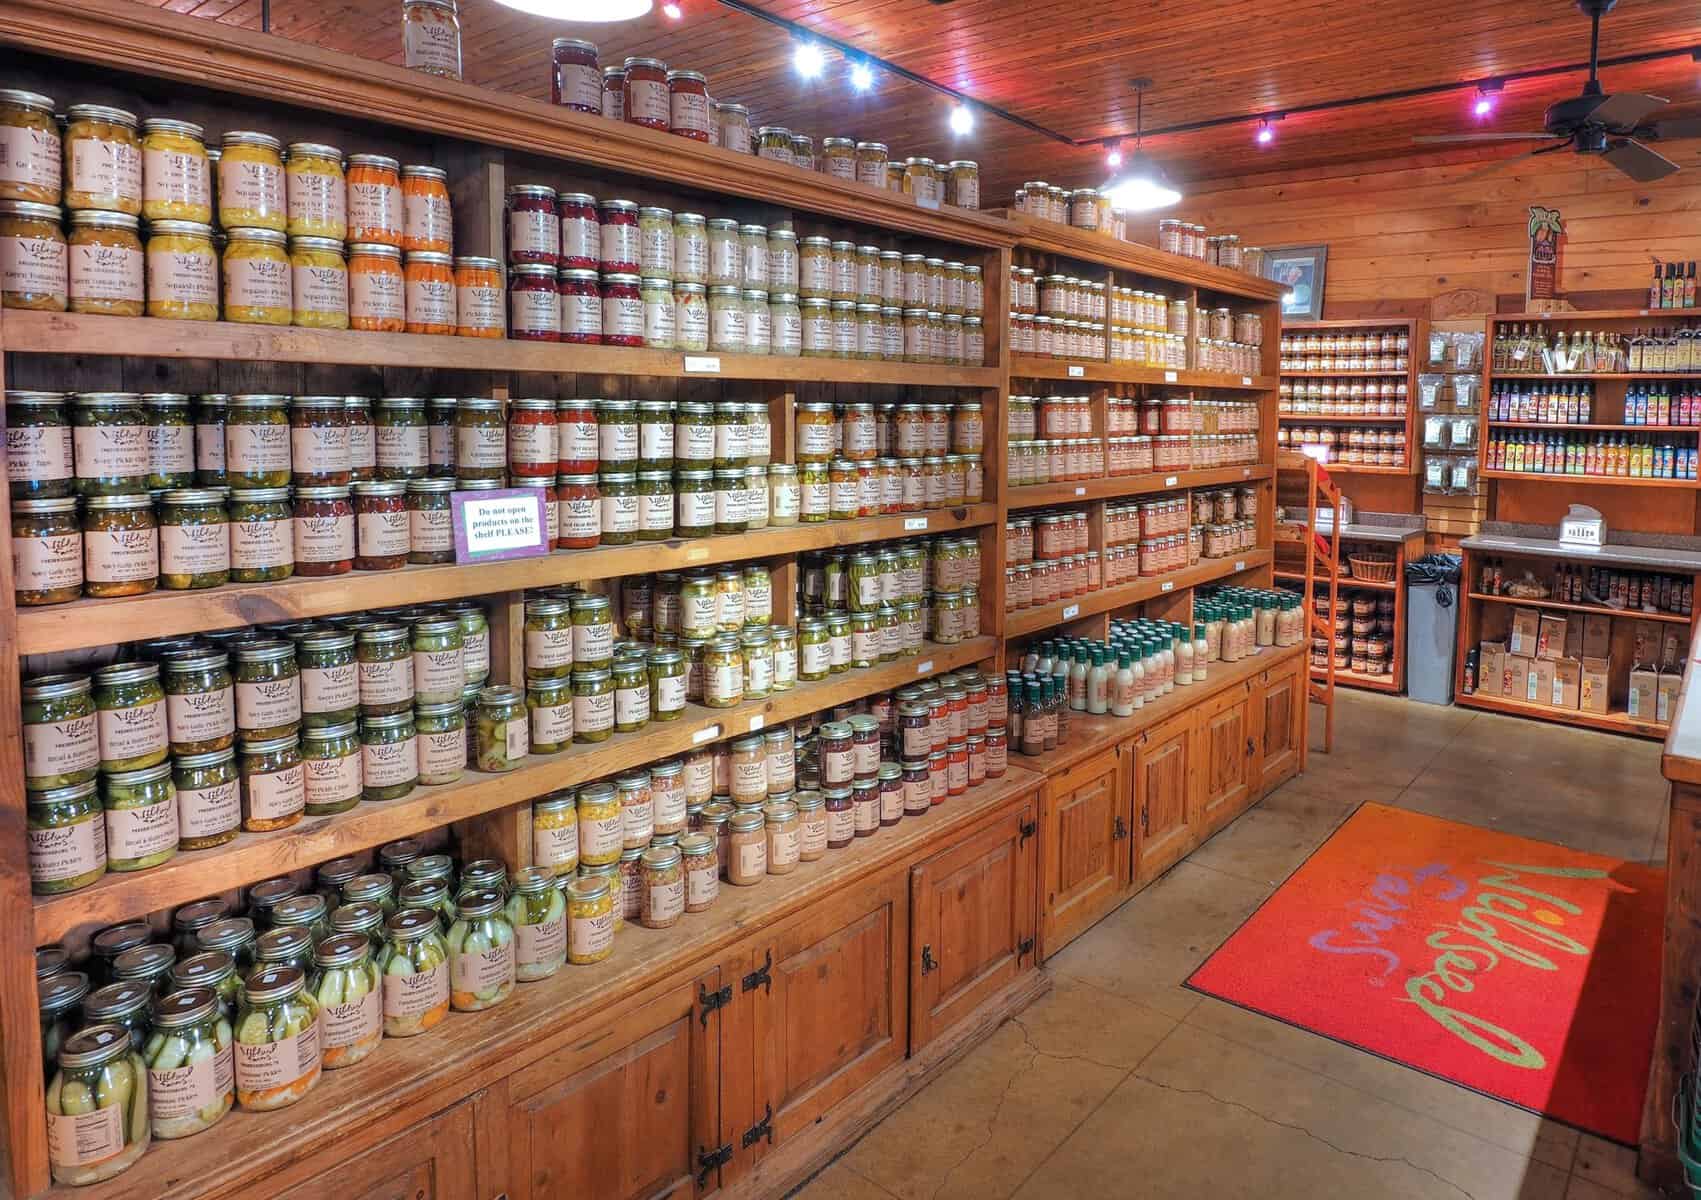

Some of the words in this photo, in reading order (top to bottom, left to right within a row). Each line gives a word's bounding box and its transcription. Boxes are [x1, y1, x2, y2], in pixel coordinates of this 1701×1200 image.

[478, 508, 490, 516] Do
[507, 506, 526, 517] open
[472, 518, 508, 529] products
[522, 516, 534, 524] the
[474, 529, 494, 539] shelf
[1309, 862, 1470, 978] Farms
[1394, 859, 1609, 1070] Wildseed
